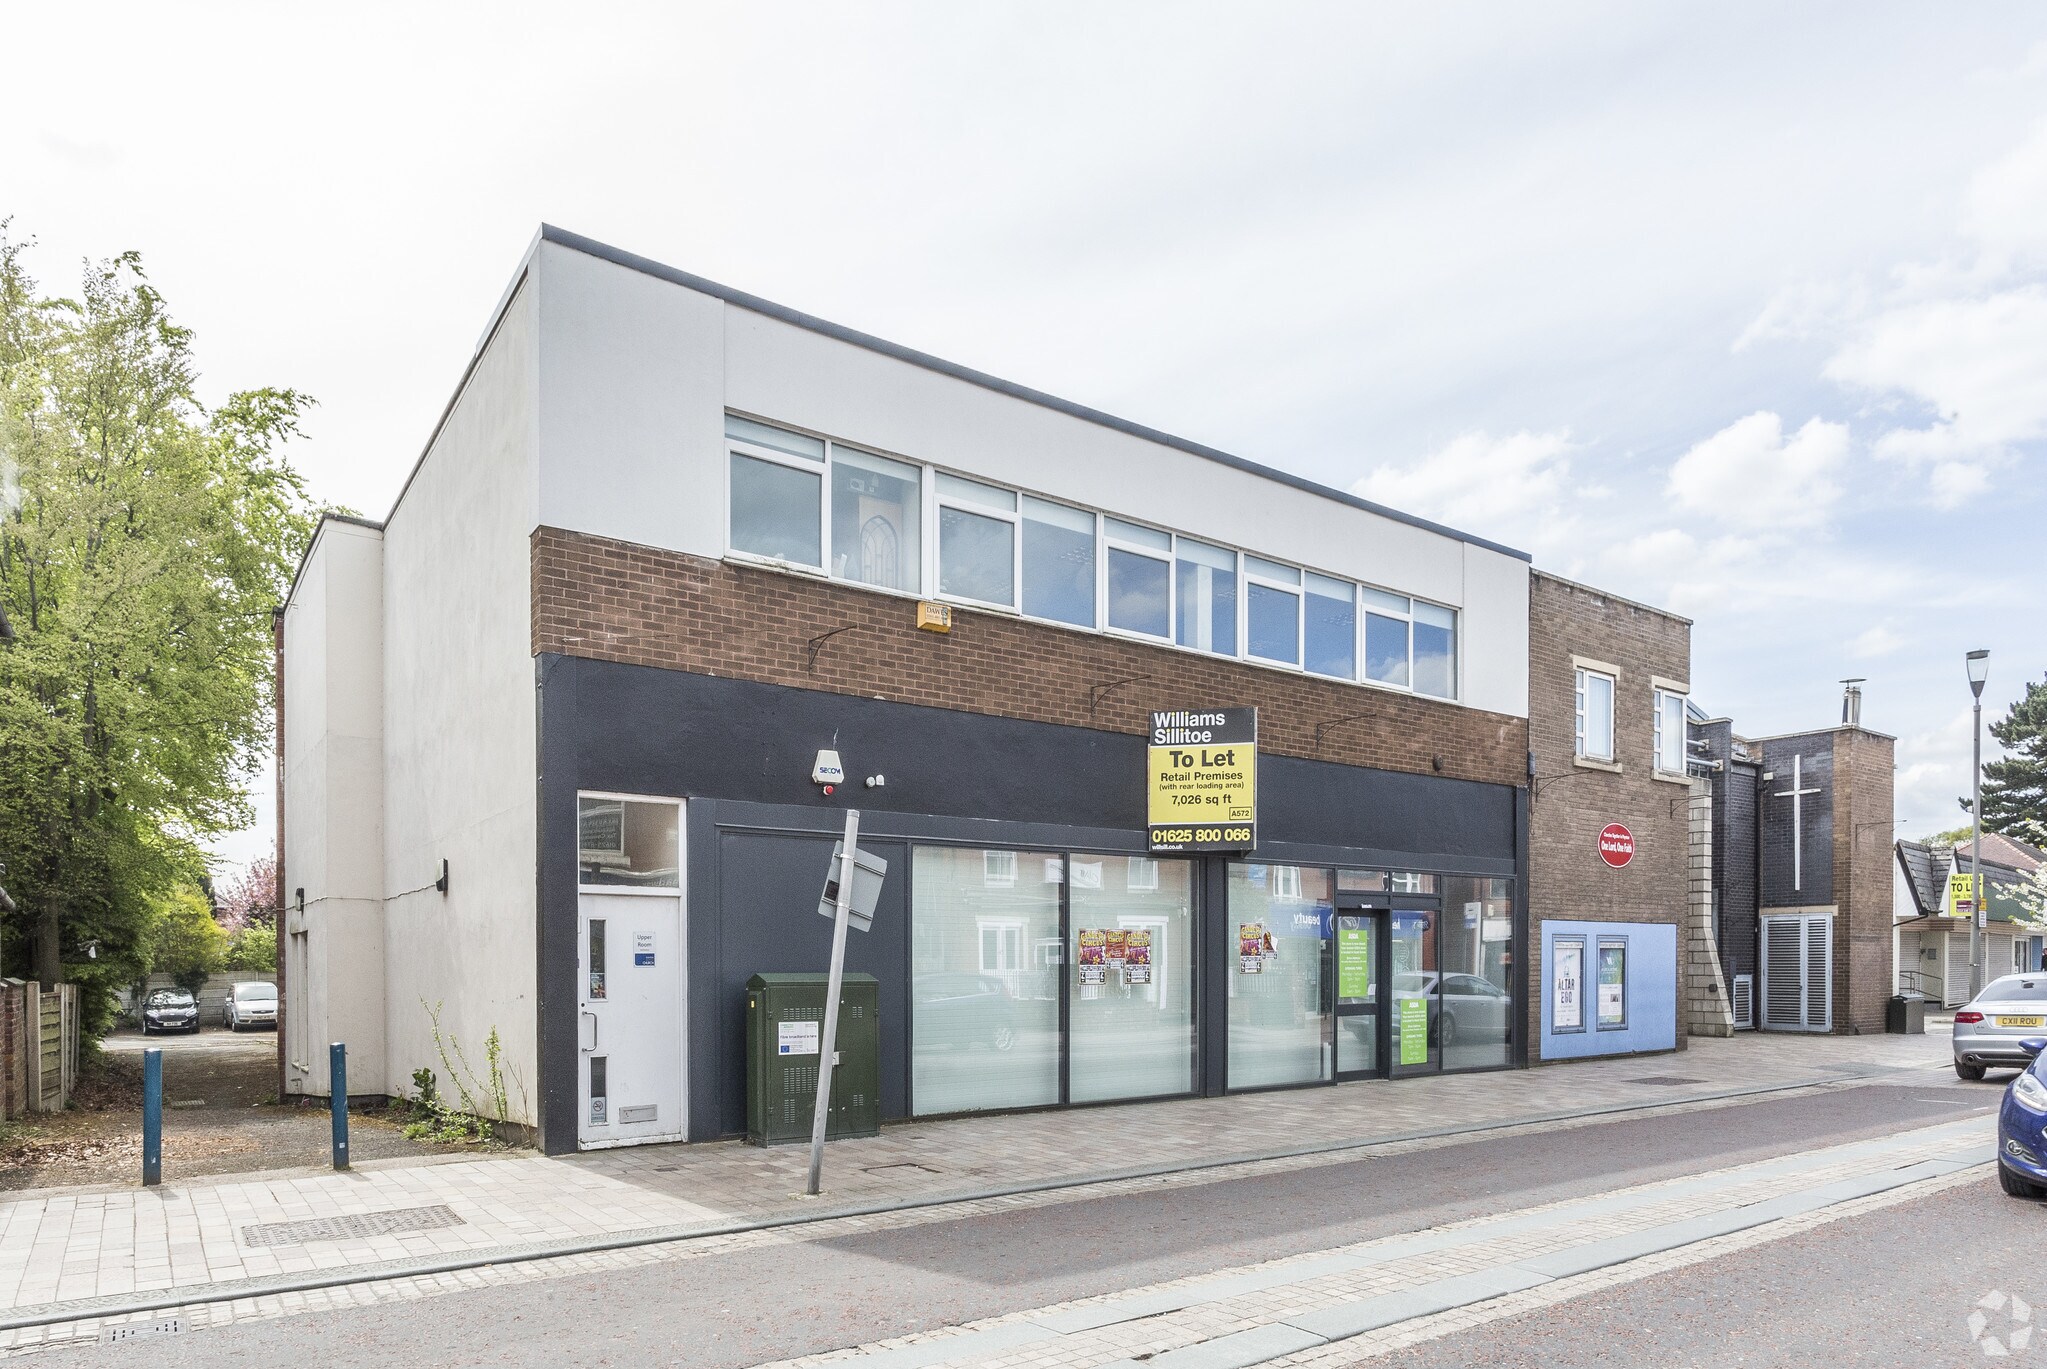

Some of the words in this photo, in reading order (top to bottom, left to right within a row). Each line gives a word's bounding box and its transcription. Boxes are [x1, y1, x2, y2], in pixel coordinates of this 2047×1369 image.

[1154, 712, 1226, 728] Williams
[1154, 728, 1212, 744] Sillitoe
[1170, 750, 1194, 768] To
[1202, 750, 1235, 767] Let
[820, 766, 841, 774] SECOM
[1160, 772, 1190, 782] Retail
[1194, 771, 1243, 781] Premises
[1159, 783, 1177, 791] (with
[1196, 782, 1223, 790] loading
[1225, 781, 1244, 790] area)
[1172, 795, 1202, 806] 7,026
[1206, 797, 1219, 806] sq
[1223, 794, 1232, 804] ft
[1152, 830, 1192, 843] 01625
[1196, 829, 1222, 842] 800
[1224, 828, 1250, 841] 066
[1951, 883, 1962, 892] TO
[1558, 978, 1575, 990] ALTAR
[1561, 991, 1572, 1003] EGO
